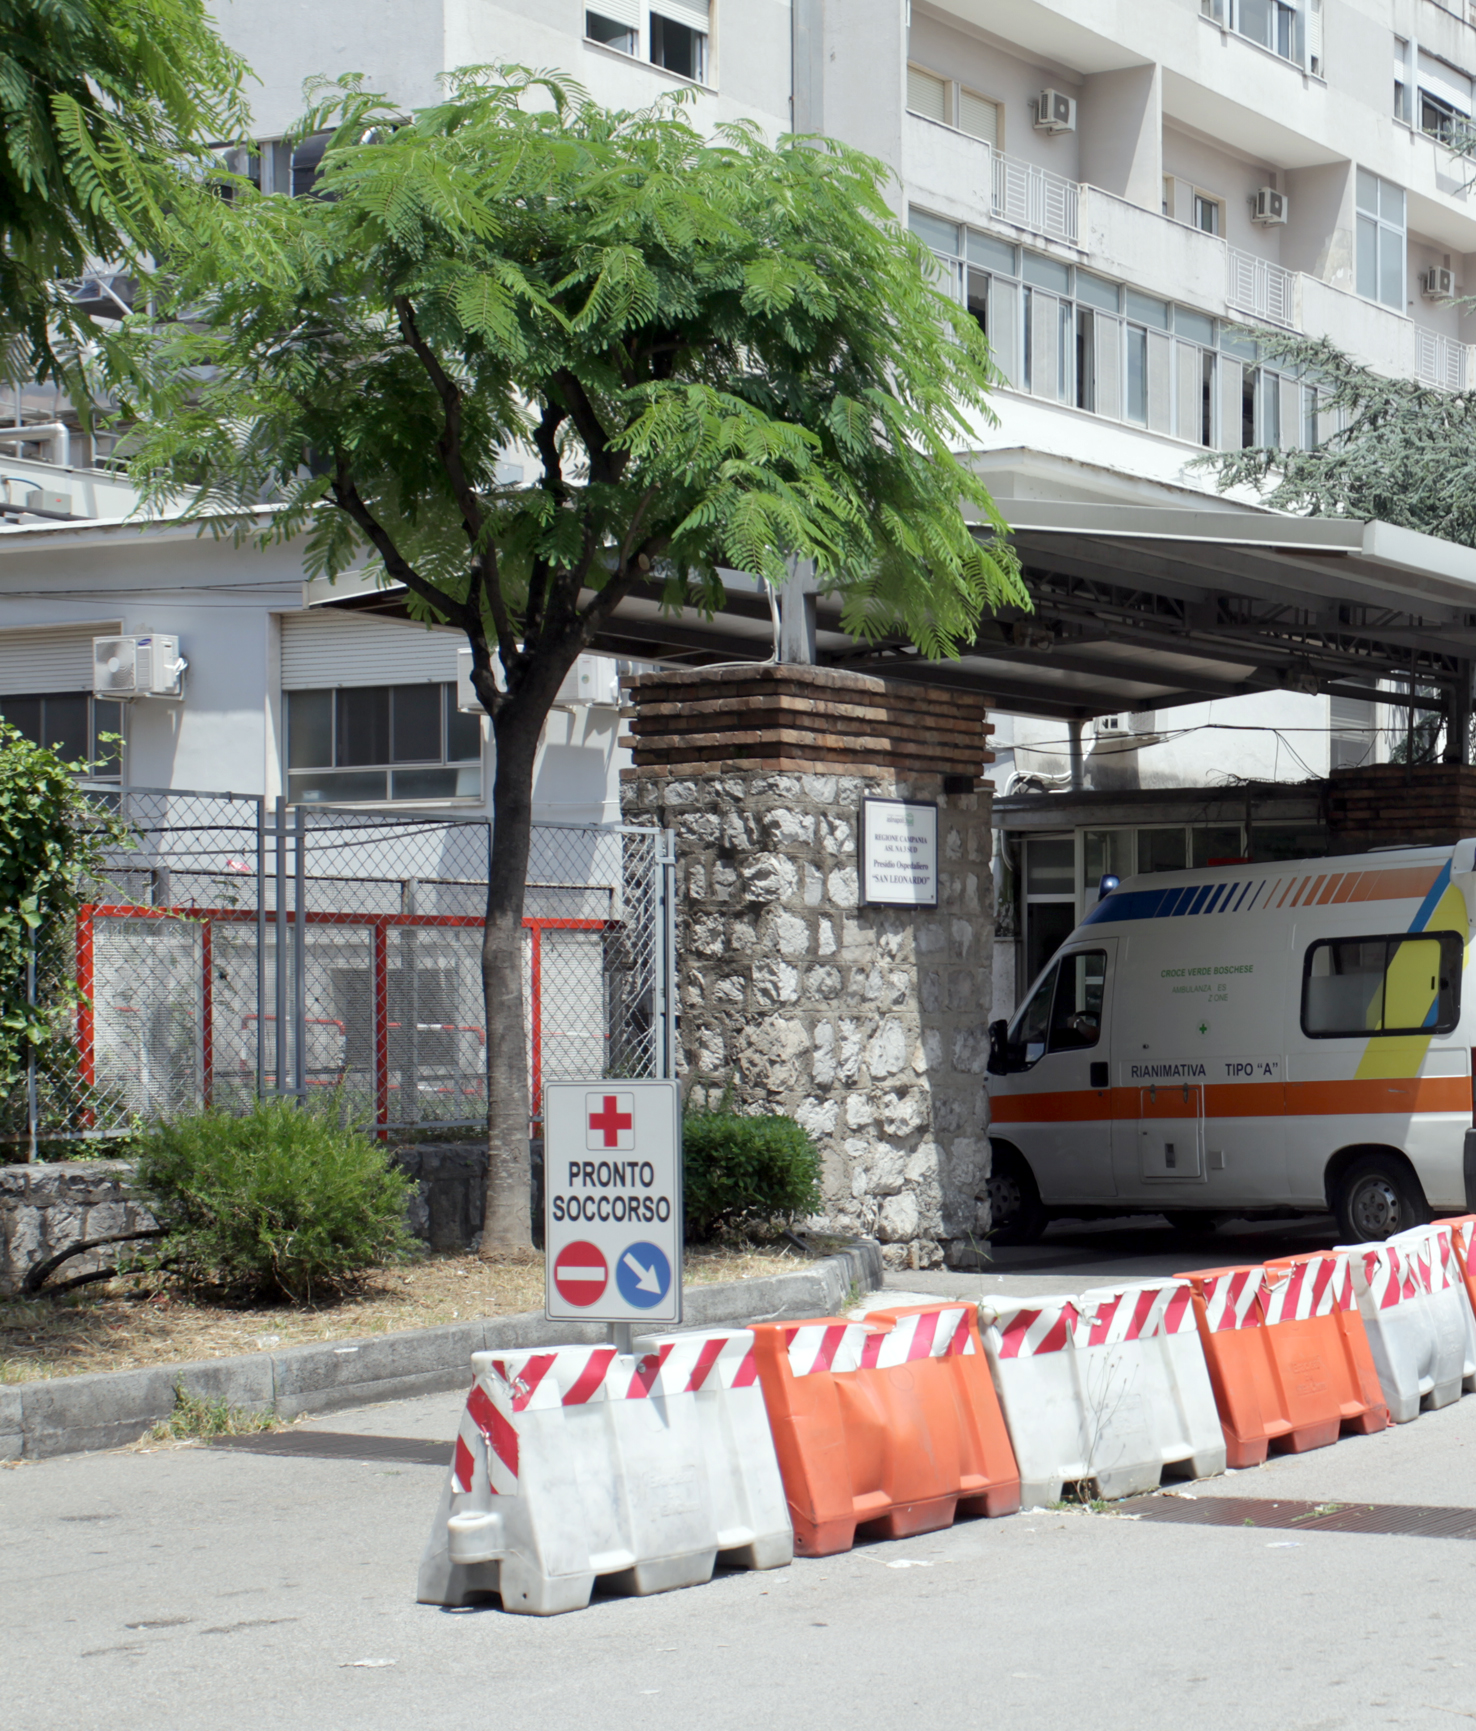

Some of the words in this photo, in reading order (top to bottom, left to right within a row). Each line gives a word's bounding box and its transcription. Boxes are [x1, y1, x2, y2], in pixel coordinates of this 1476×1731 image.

[874, 859, 895, 868] Presidio
[896, 860, 929, 871] Ospedaliero
[1160, 968, 1186, 978] CROCE
[1188, 967, 1212, 977] VERDE
[1213, 965, 1254, 974] BOSCHESE
[1172, 984, 1212, 994] AMBULANZA
[1217, 984, 1227, 992] ES
[1131, 1064, 1206, 1078] RIANIMATIVA
[1225, 1063, 1253, 1076] TIPO
[568, 1161, 654, 1187] PRONTO
[553, 1195, 670, 1222] SOCCORSO
